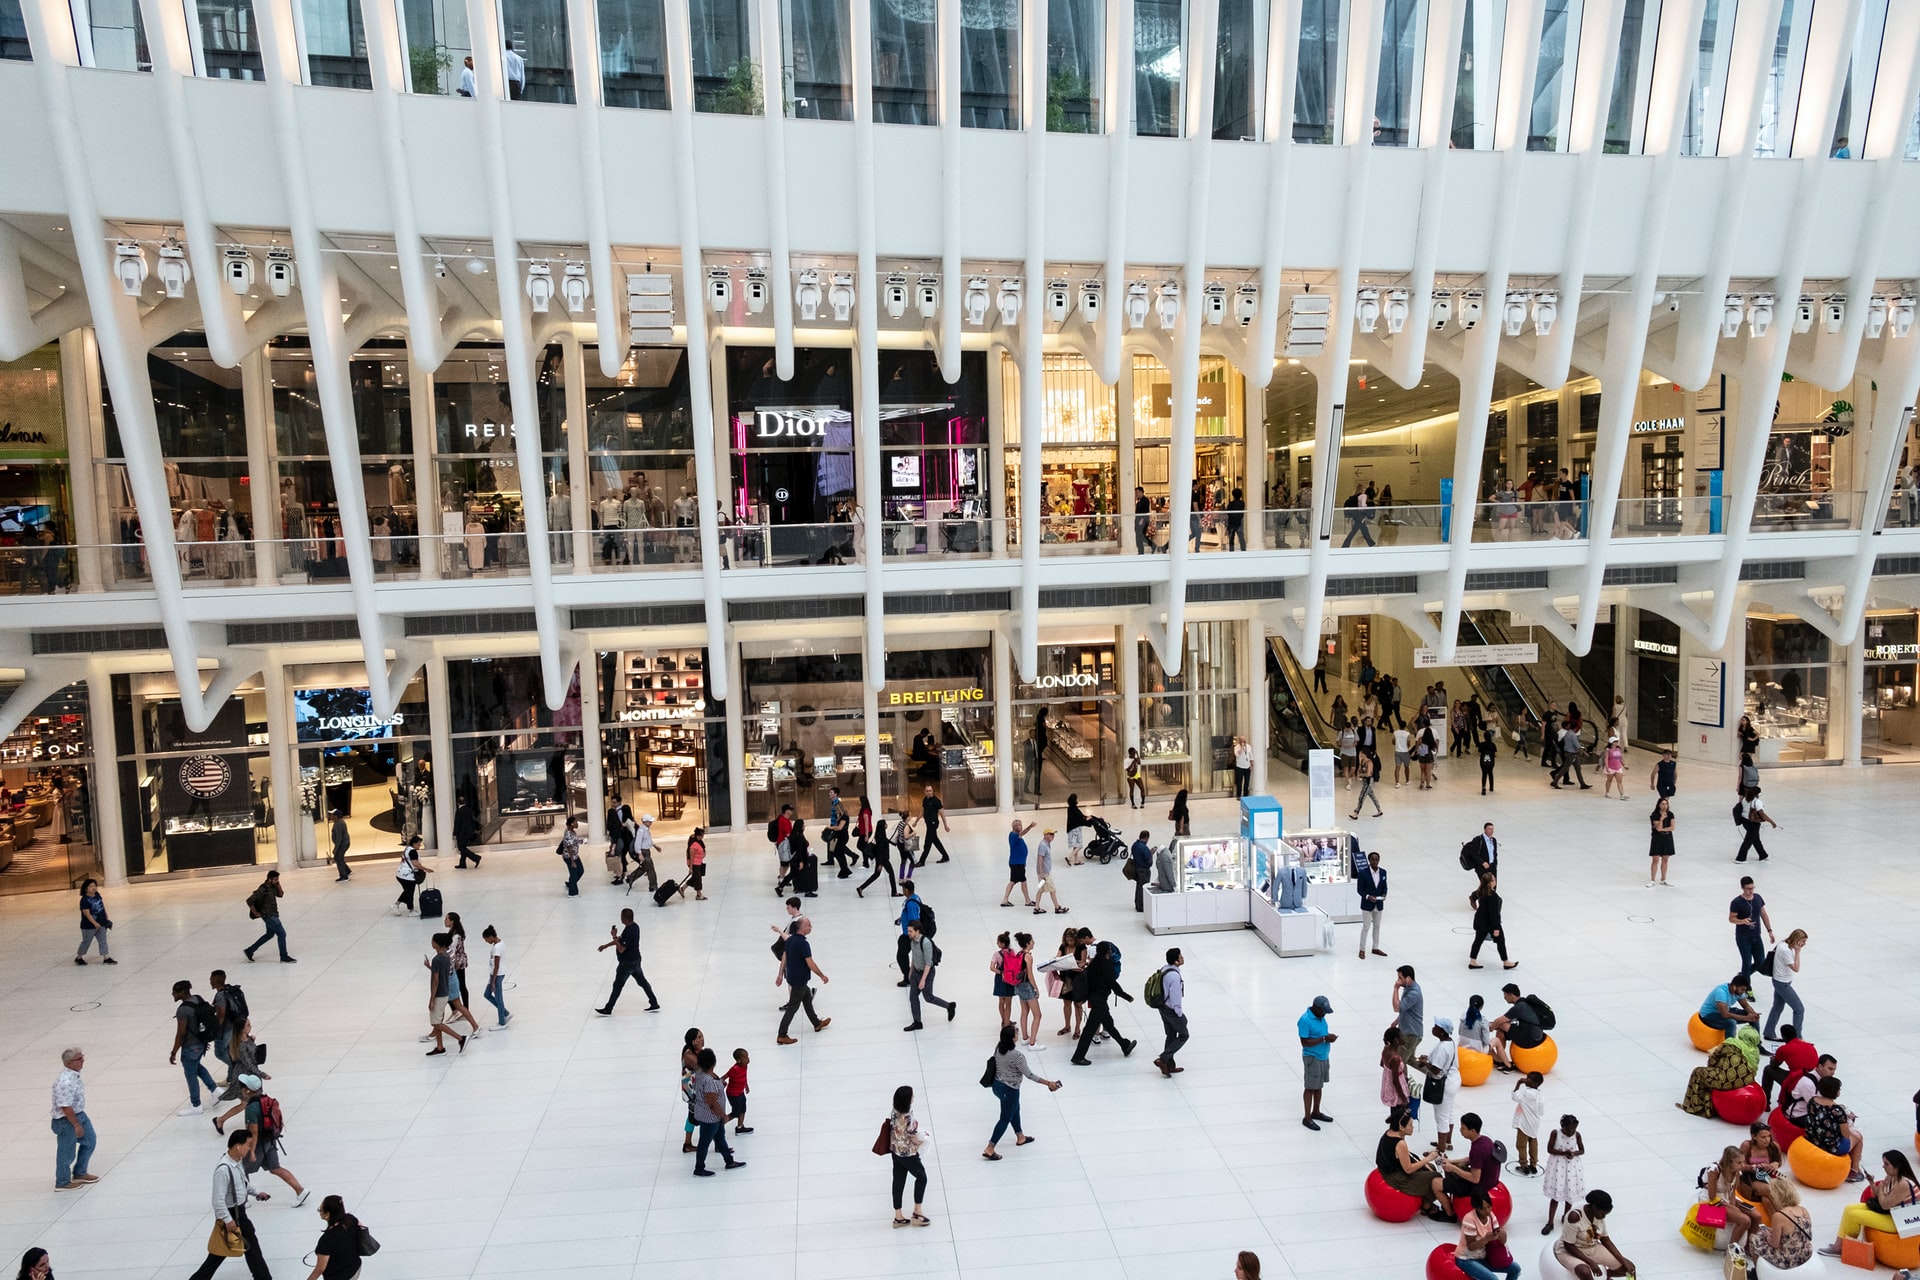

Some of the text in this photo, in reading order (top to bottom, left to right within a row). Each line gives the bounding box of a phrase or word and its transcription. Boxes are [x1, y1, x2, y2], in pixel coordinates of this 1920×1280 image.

[757, 411, 833, 437] Dior
[1634, 417, 1685, 432] COLE HAAN
[1036, 673, 1099, 689] LONDON
[890, 689, 984, 705] BREITLING
[620, 707, 697, 722] MONTBLANC
[181, 763, 197, 794] EDITION
[203, 761, 230, 797] EXCLUSIVE
